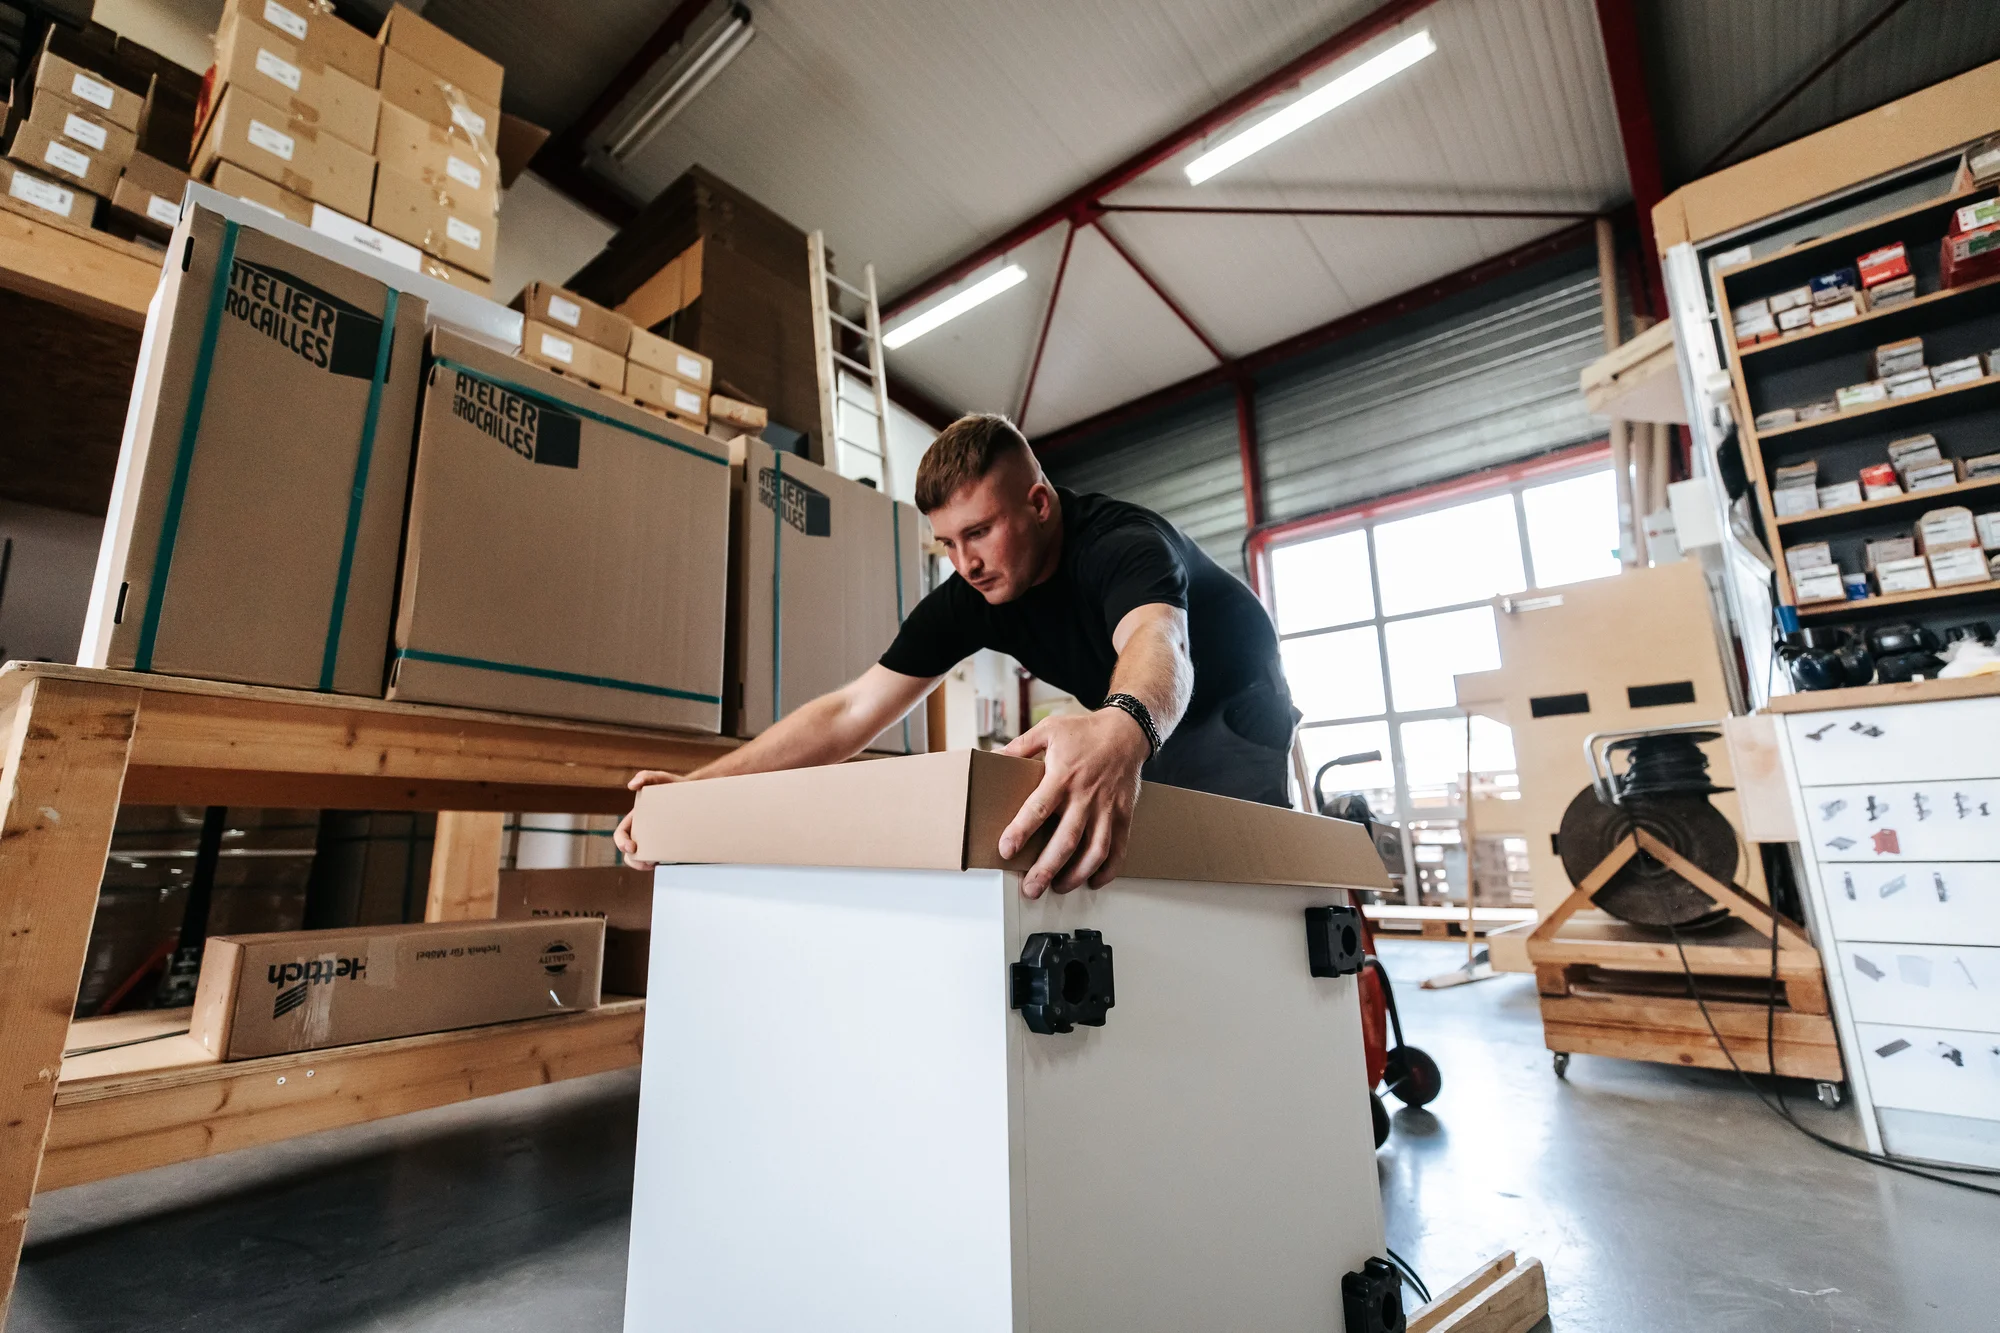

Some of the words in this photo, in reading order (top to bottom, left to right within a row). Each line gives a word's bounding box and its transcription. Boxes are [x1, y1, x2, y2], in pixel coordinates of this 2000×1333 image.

[225, 287, 329, 369] ROCAILLES
[455, 371, 538, 433] ATELIER
[457, 396, 534, 461] ROCAILLES
[759, 468, 805, 512] ATEIER
[416, 949, 447, 961] Möbel
[467, 944, 501, 956] Technik
[538, 953, 576, 965] QUALITY
[267, 957, 368, 990] Hettich
